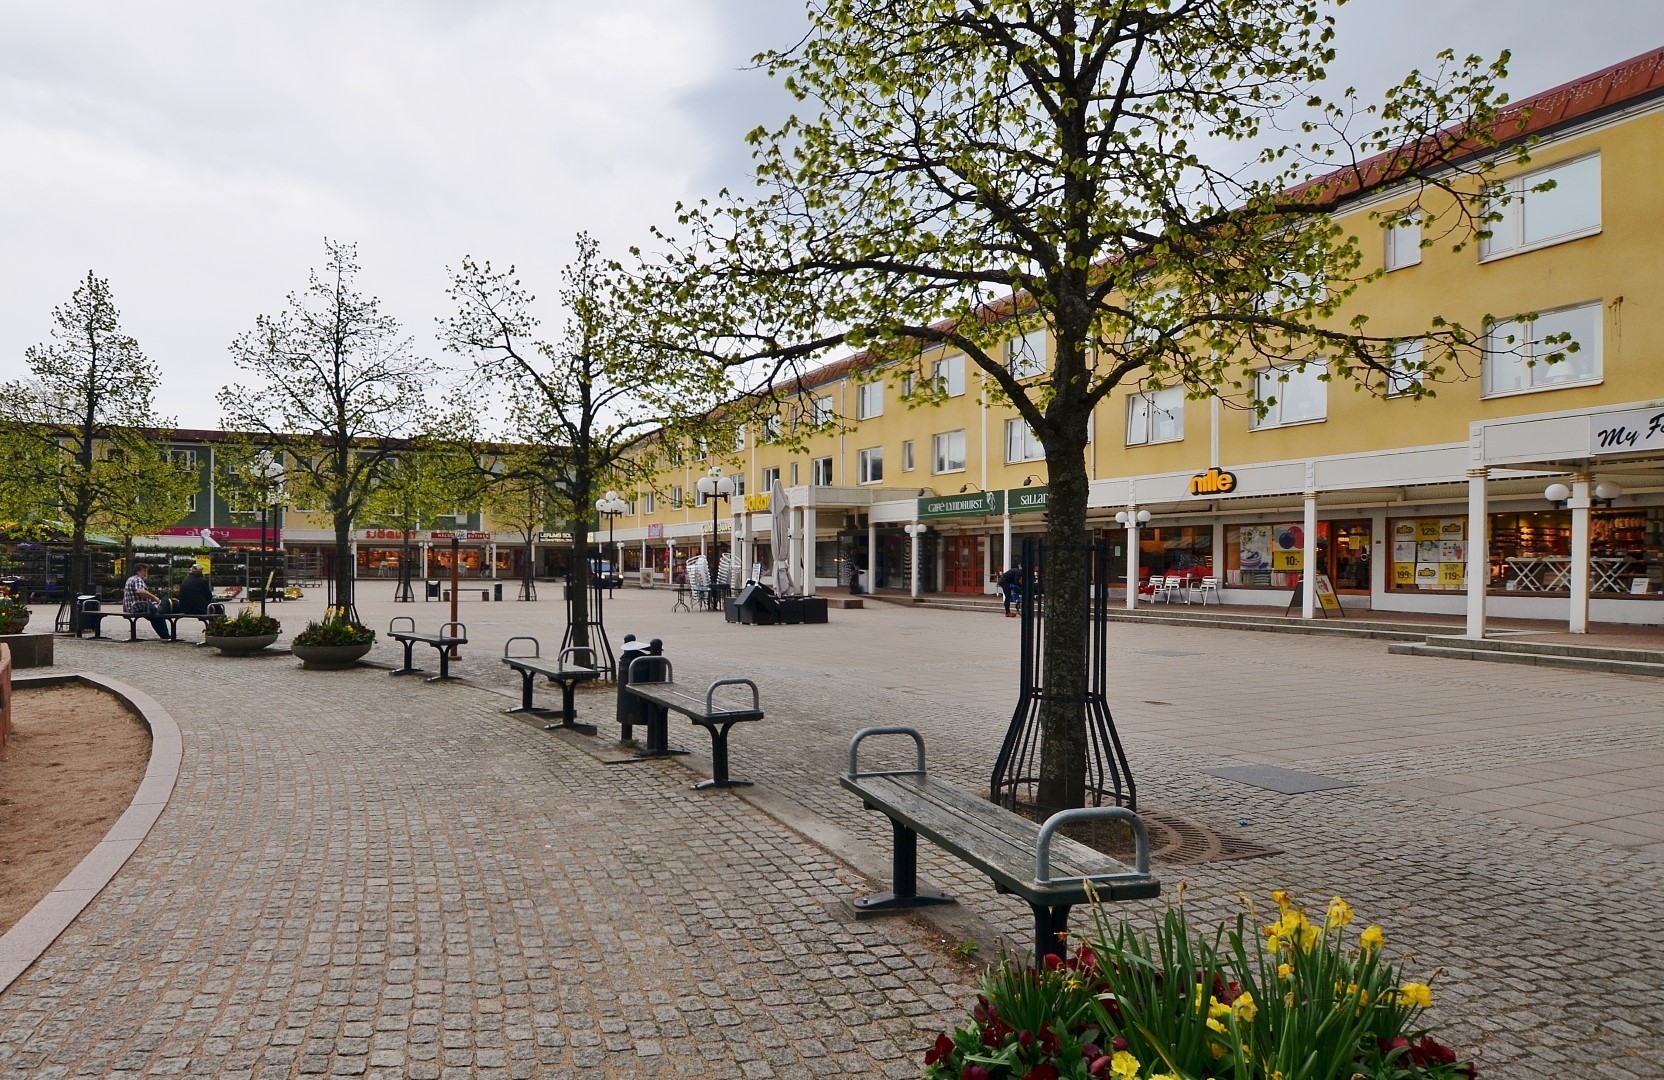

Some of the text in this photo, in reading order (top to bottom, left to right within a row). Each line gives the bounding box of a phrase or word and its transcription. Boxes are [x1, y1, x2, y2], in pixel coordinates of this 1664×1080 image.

[1597, 426, 1640, 448] My
[1190, 468, 1234, 494] nille
[186, 528, 230, 538] glry
[1285, 556, 1299, 566] 10:-
